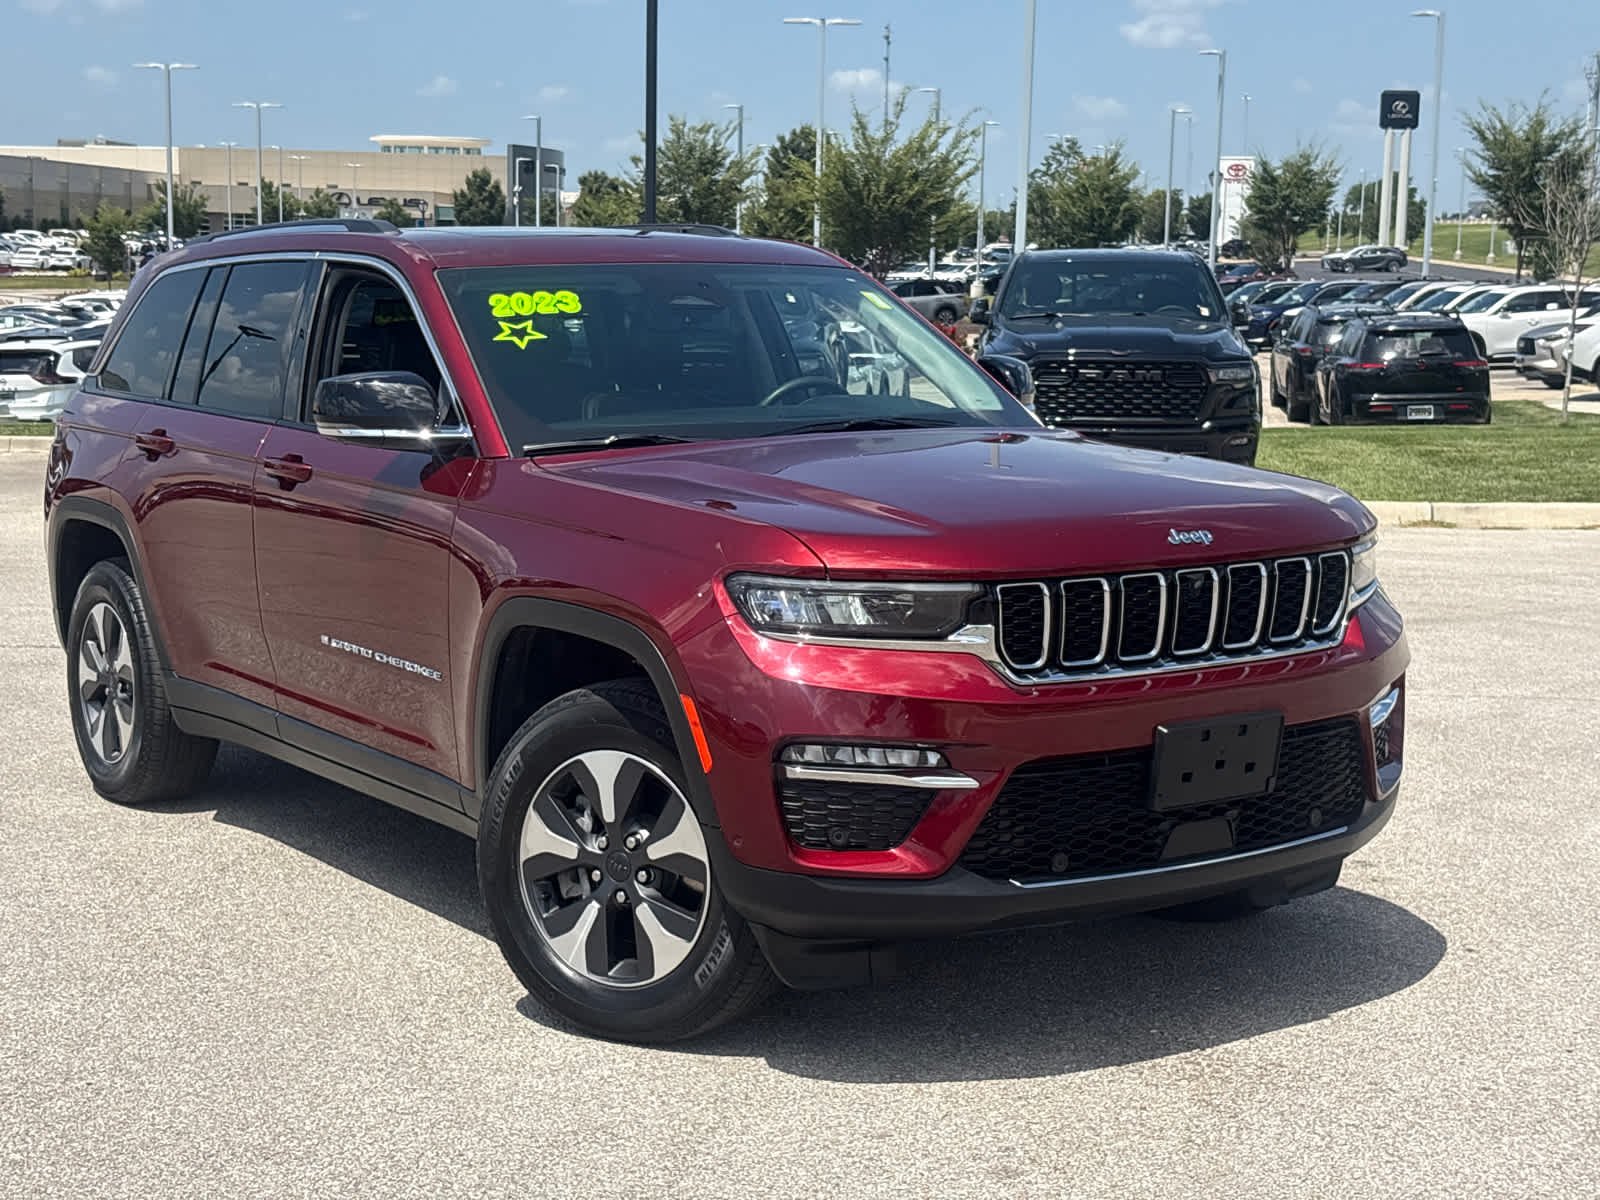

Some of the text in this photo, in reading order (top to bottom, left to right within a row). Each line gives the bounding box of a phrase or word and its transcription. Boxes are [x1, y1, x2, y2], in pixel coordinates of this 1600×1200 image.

[356, 196, 429, 208] LEUS
[489, 289, 582, 317] 2023
[1078, 368, 1163, 382] RAM
[1167, 527, 1213, 545] Jeep
[330, 638, 442, 681] GRAND CHEROKEE
[489, 759, 522, 845] MICHELIN
[697, 914, 732, 986] CHELIN
